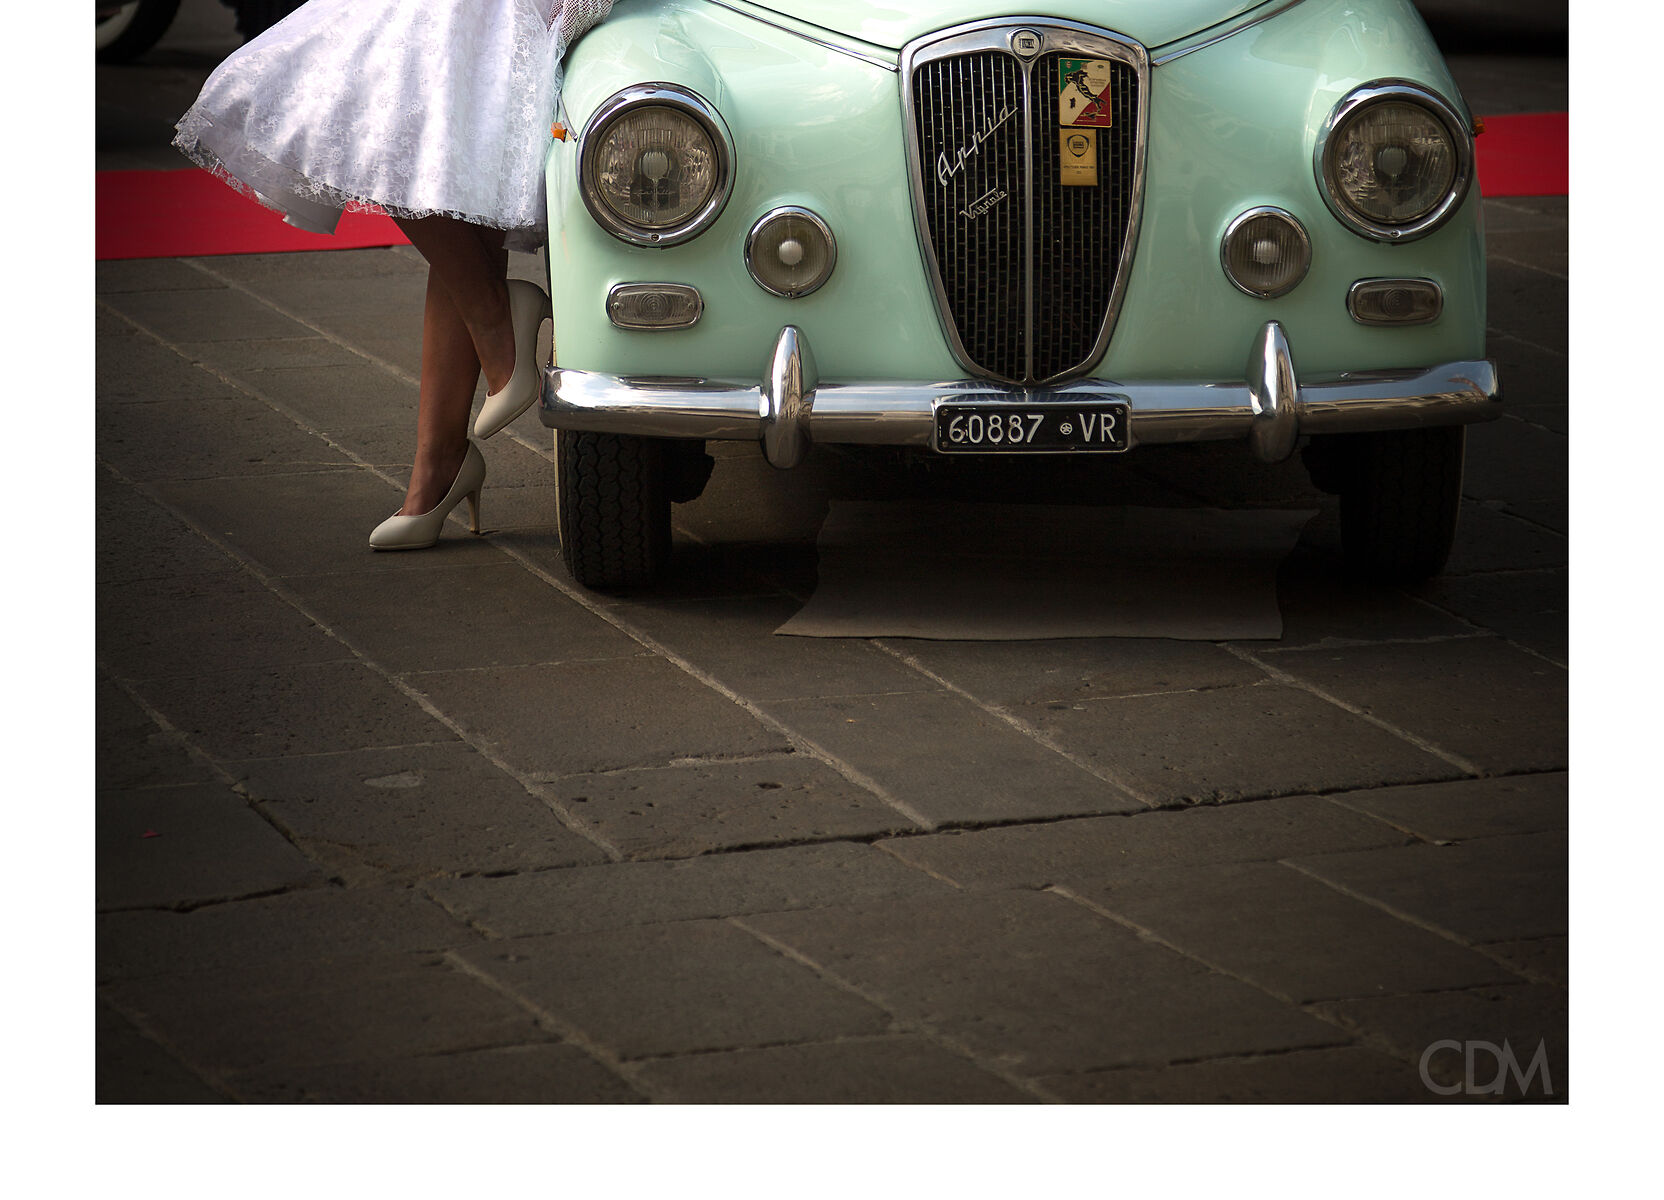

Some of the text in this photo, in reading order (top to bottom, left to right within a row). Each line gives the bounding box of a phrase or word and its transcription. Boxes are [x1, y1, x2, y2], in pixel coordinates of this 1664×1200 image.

[938, 105, 1018, 187] Appia
[950, 413, 1116, 444] 60887 VR
